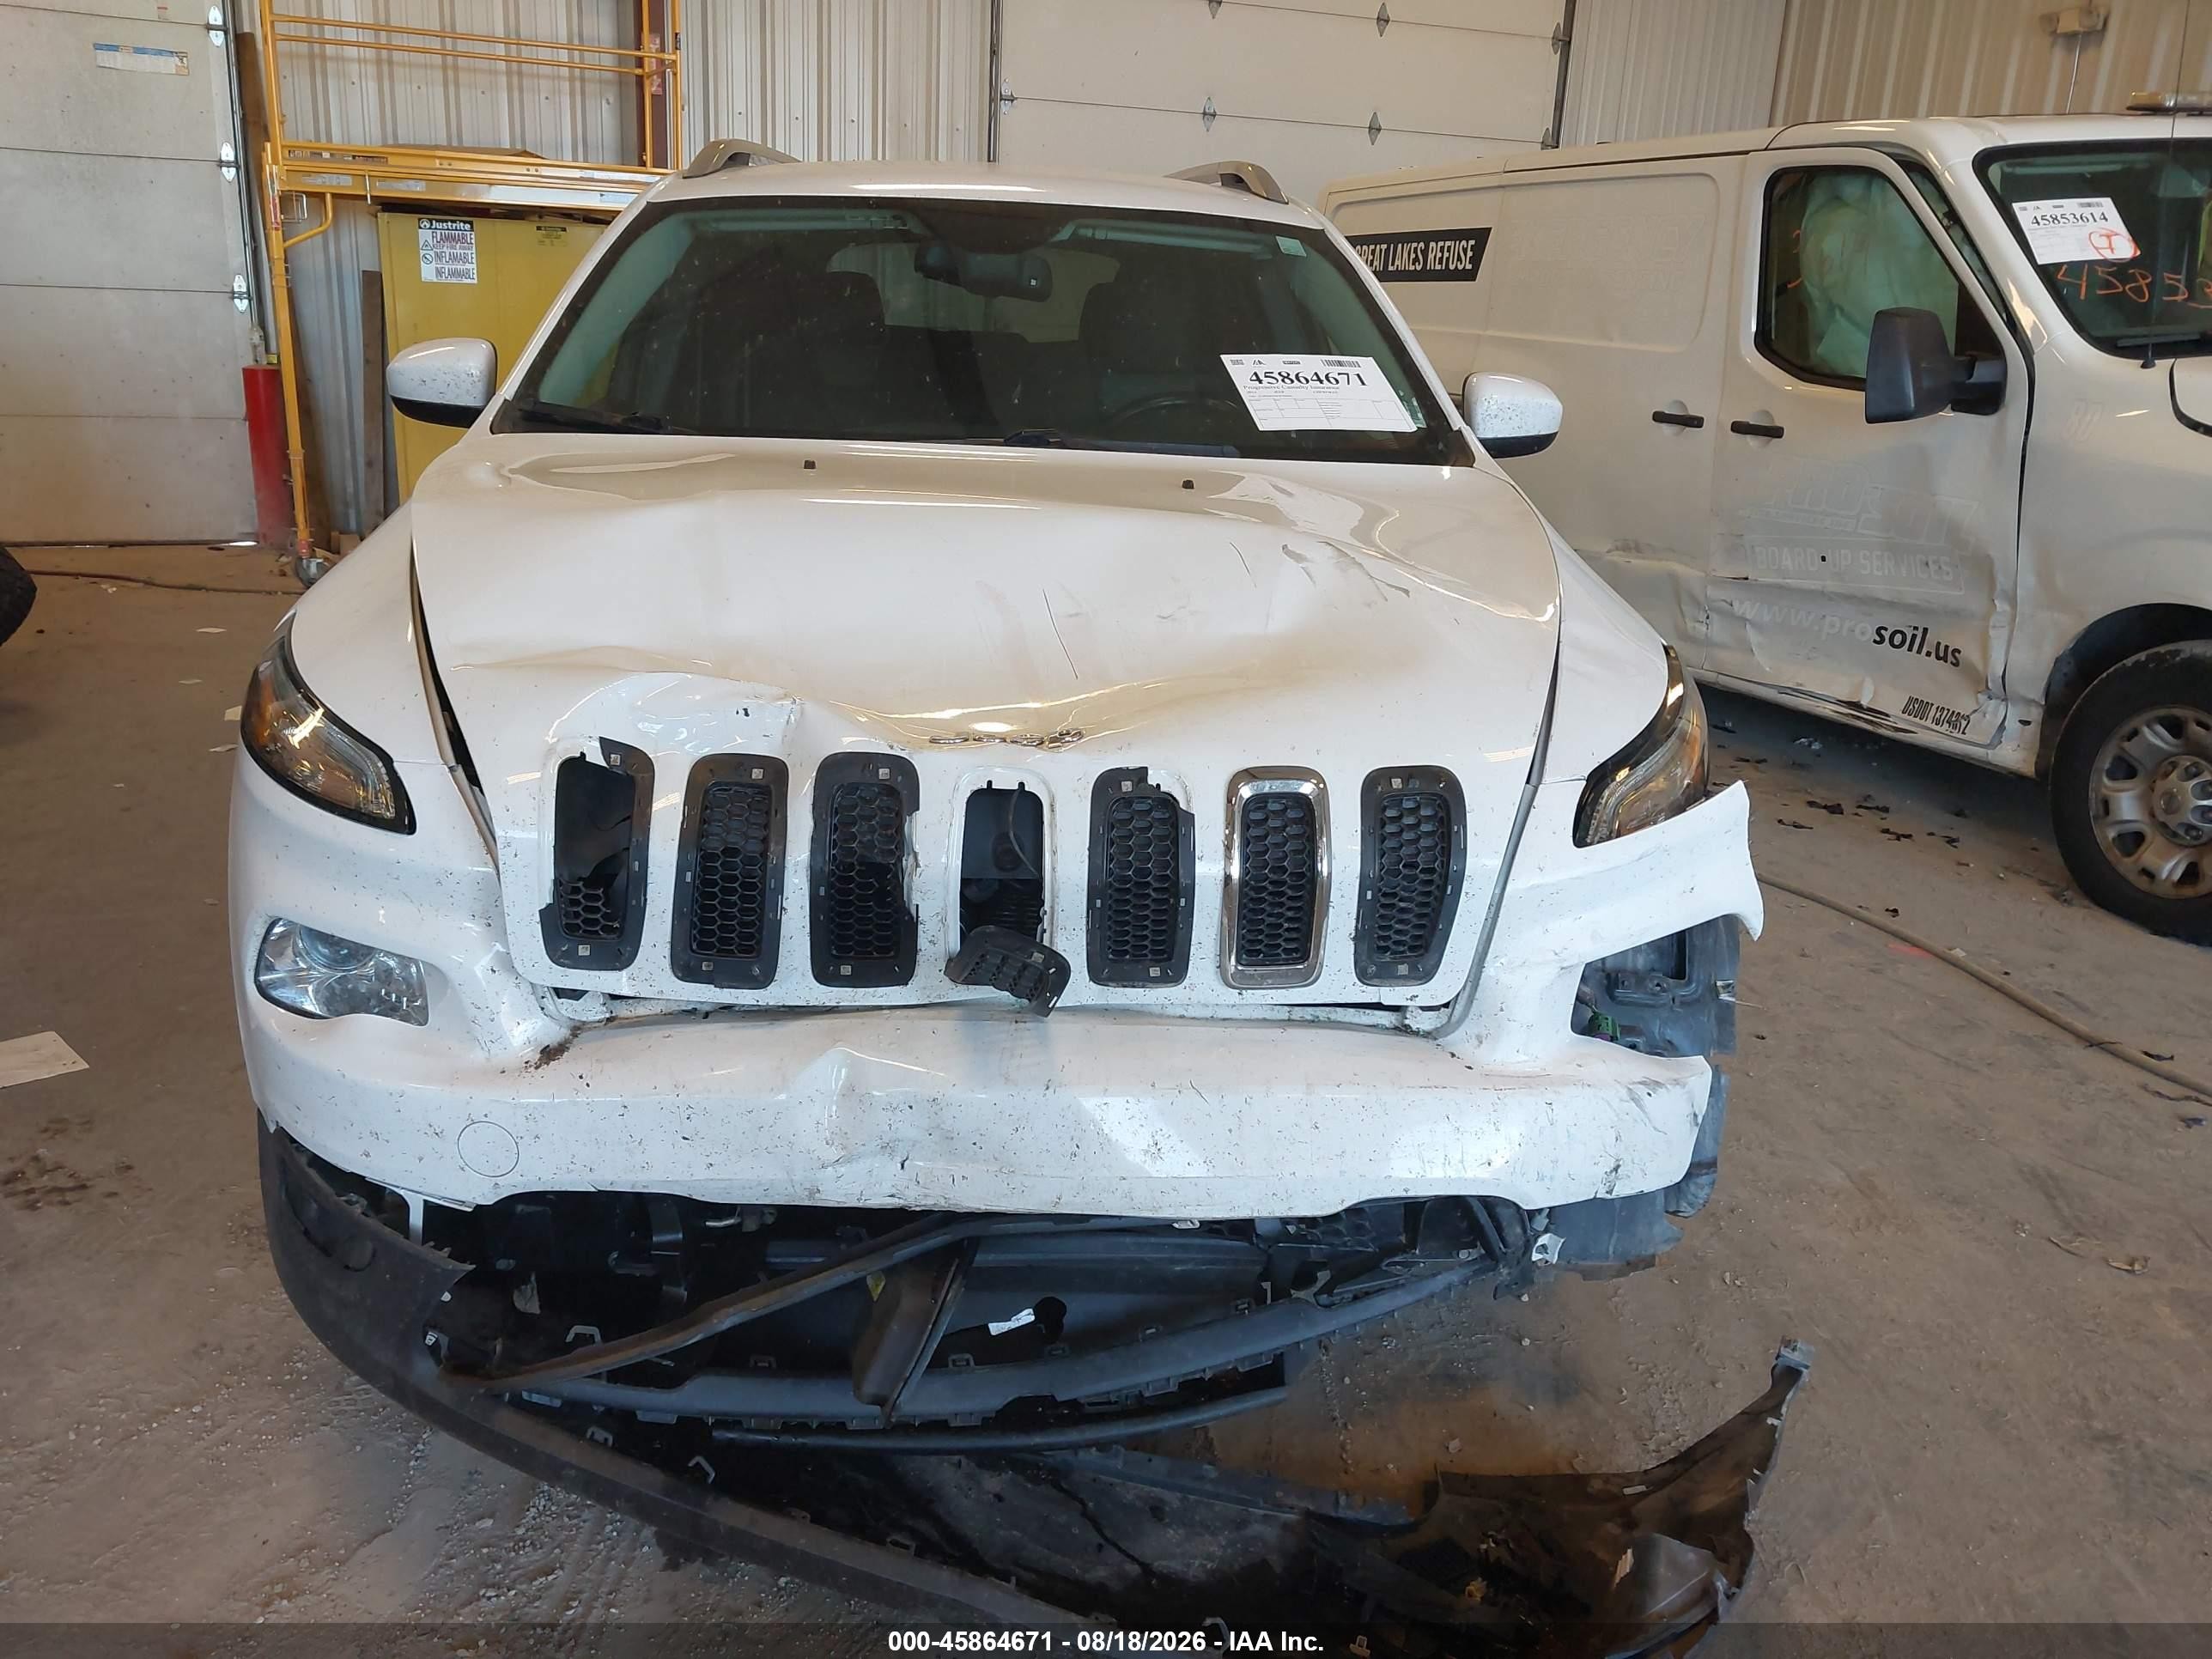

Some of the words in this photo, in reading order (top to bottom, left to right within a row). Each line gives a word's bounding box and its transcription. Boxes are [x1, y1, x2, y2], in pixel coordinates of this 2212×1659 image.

[431, 220, 471, 230] Justrite
[2031, 211, 2109, 227] 45853614
[431, 231, 474, 245] FLAMMABLE
[434, 251, 475, 264] INFLAMABLE
[1388, 243, 1425, 271] LAKES
[1426, 240, 1476, 270] REFUSE
[434, 266, 476, 280] INFLAMMABLE
[1249, 371, 1368, 386] 45864671
[1901, 696, 1935, 722] USDOT
